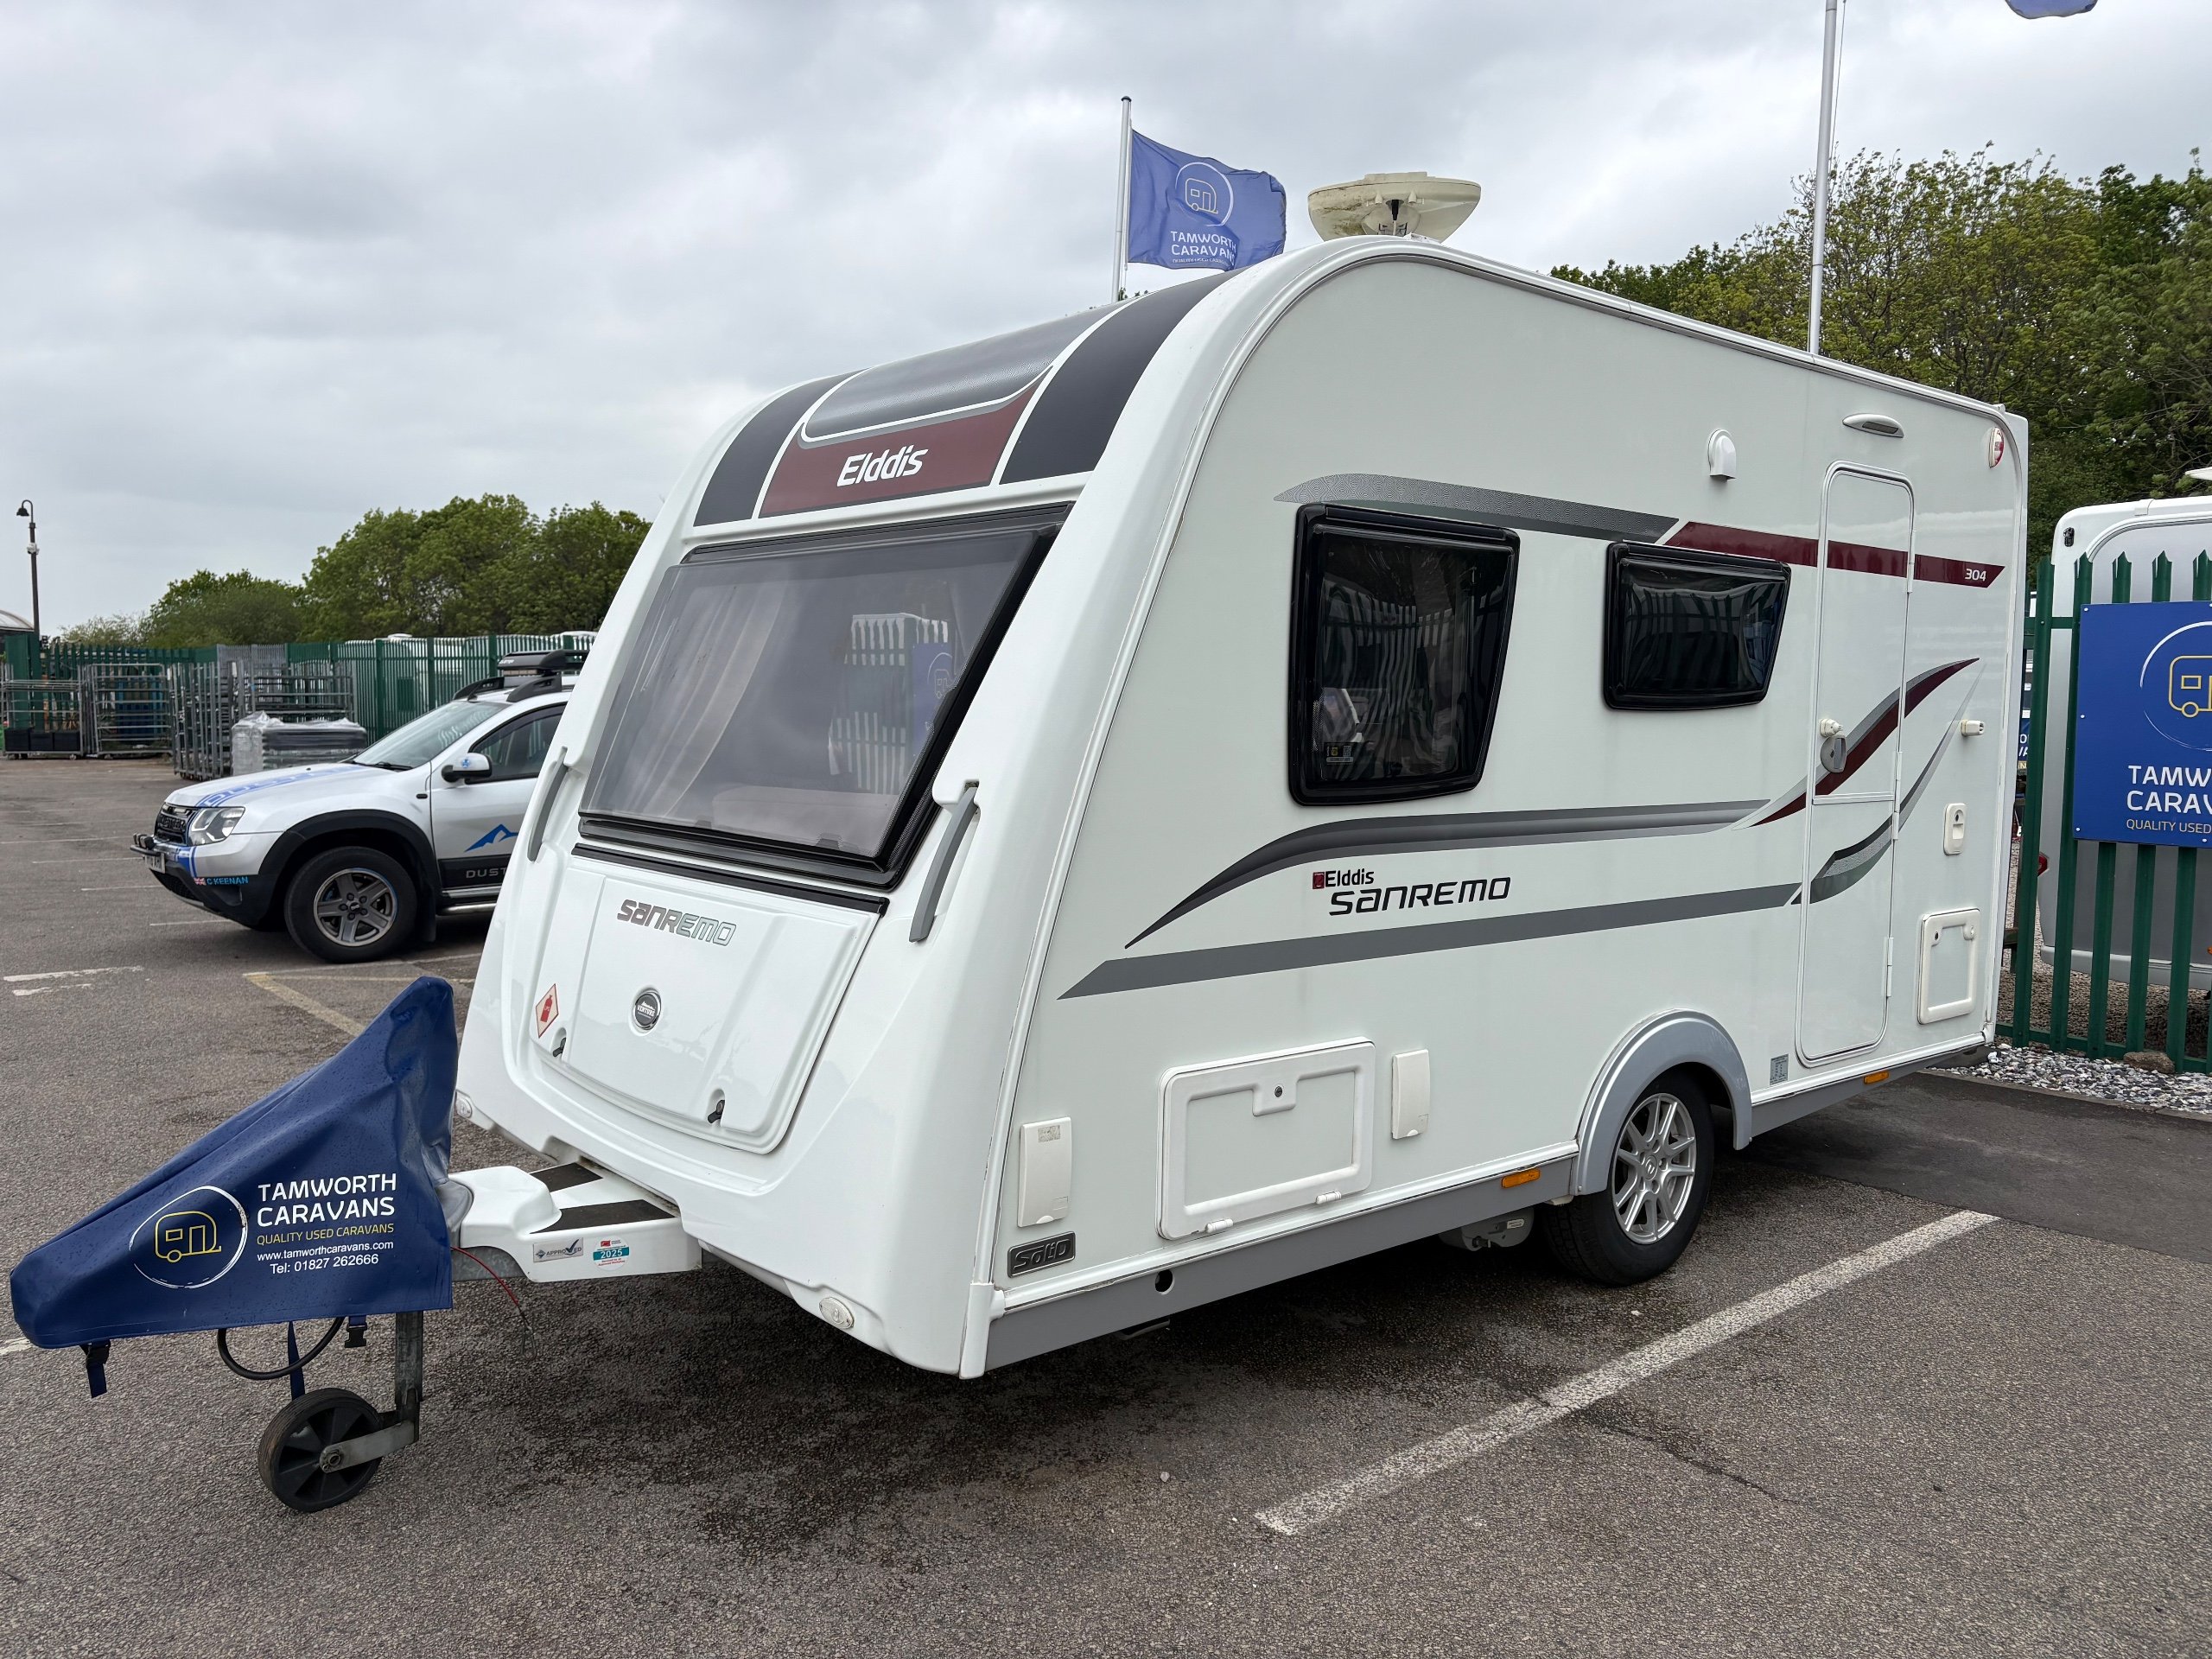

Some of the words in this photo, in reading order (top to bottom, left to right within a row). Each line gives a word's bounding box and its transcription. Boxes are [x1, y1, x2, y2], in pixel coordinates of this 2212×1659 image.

[1170, 231, 1236, 253] TAMWORTH
[836, 444, 929, 487] Elddis
[1964, 568, 1986, 582] 304
[2126, 818, 2177, 831] QUALITY
[2179, 822, 2212, 834] USED
[213, 875, 249, 885] KEENAN
[1325, 868, 1375, 887] Elddis
[257, 1173, 397, 1202] TAMWORTH
[257, 1196, 395, 1227] CARAVANS
[257, 1231, 302, 1246] QUALITY
[305, 1228, 334, 1241] USED
[336, 1223, 394, 1236] CARAVANS
[257, 1241, 394, 1262] www.tamworthcaravans.com
[601, 1249, 623, 1259] 2025
[270, 1262, 290, 1274] Tel:
[294, 1257, 330, 1272] 01827
[333, 1254, 379, 1268] 262666
